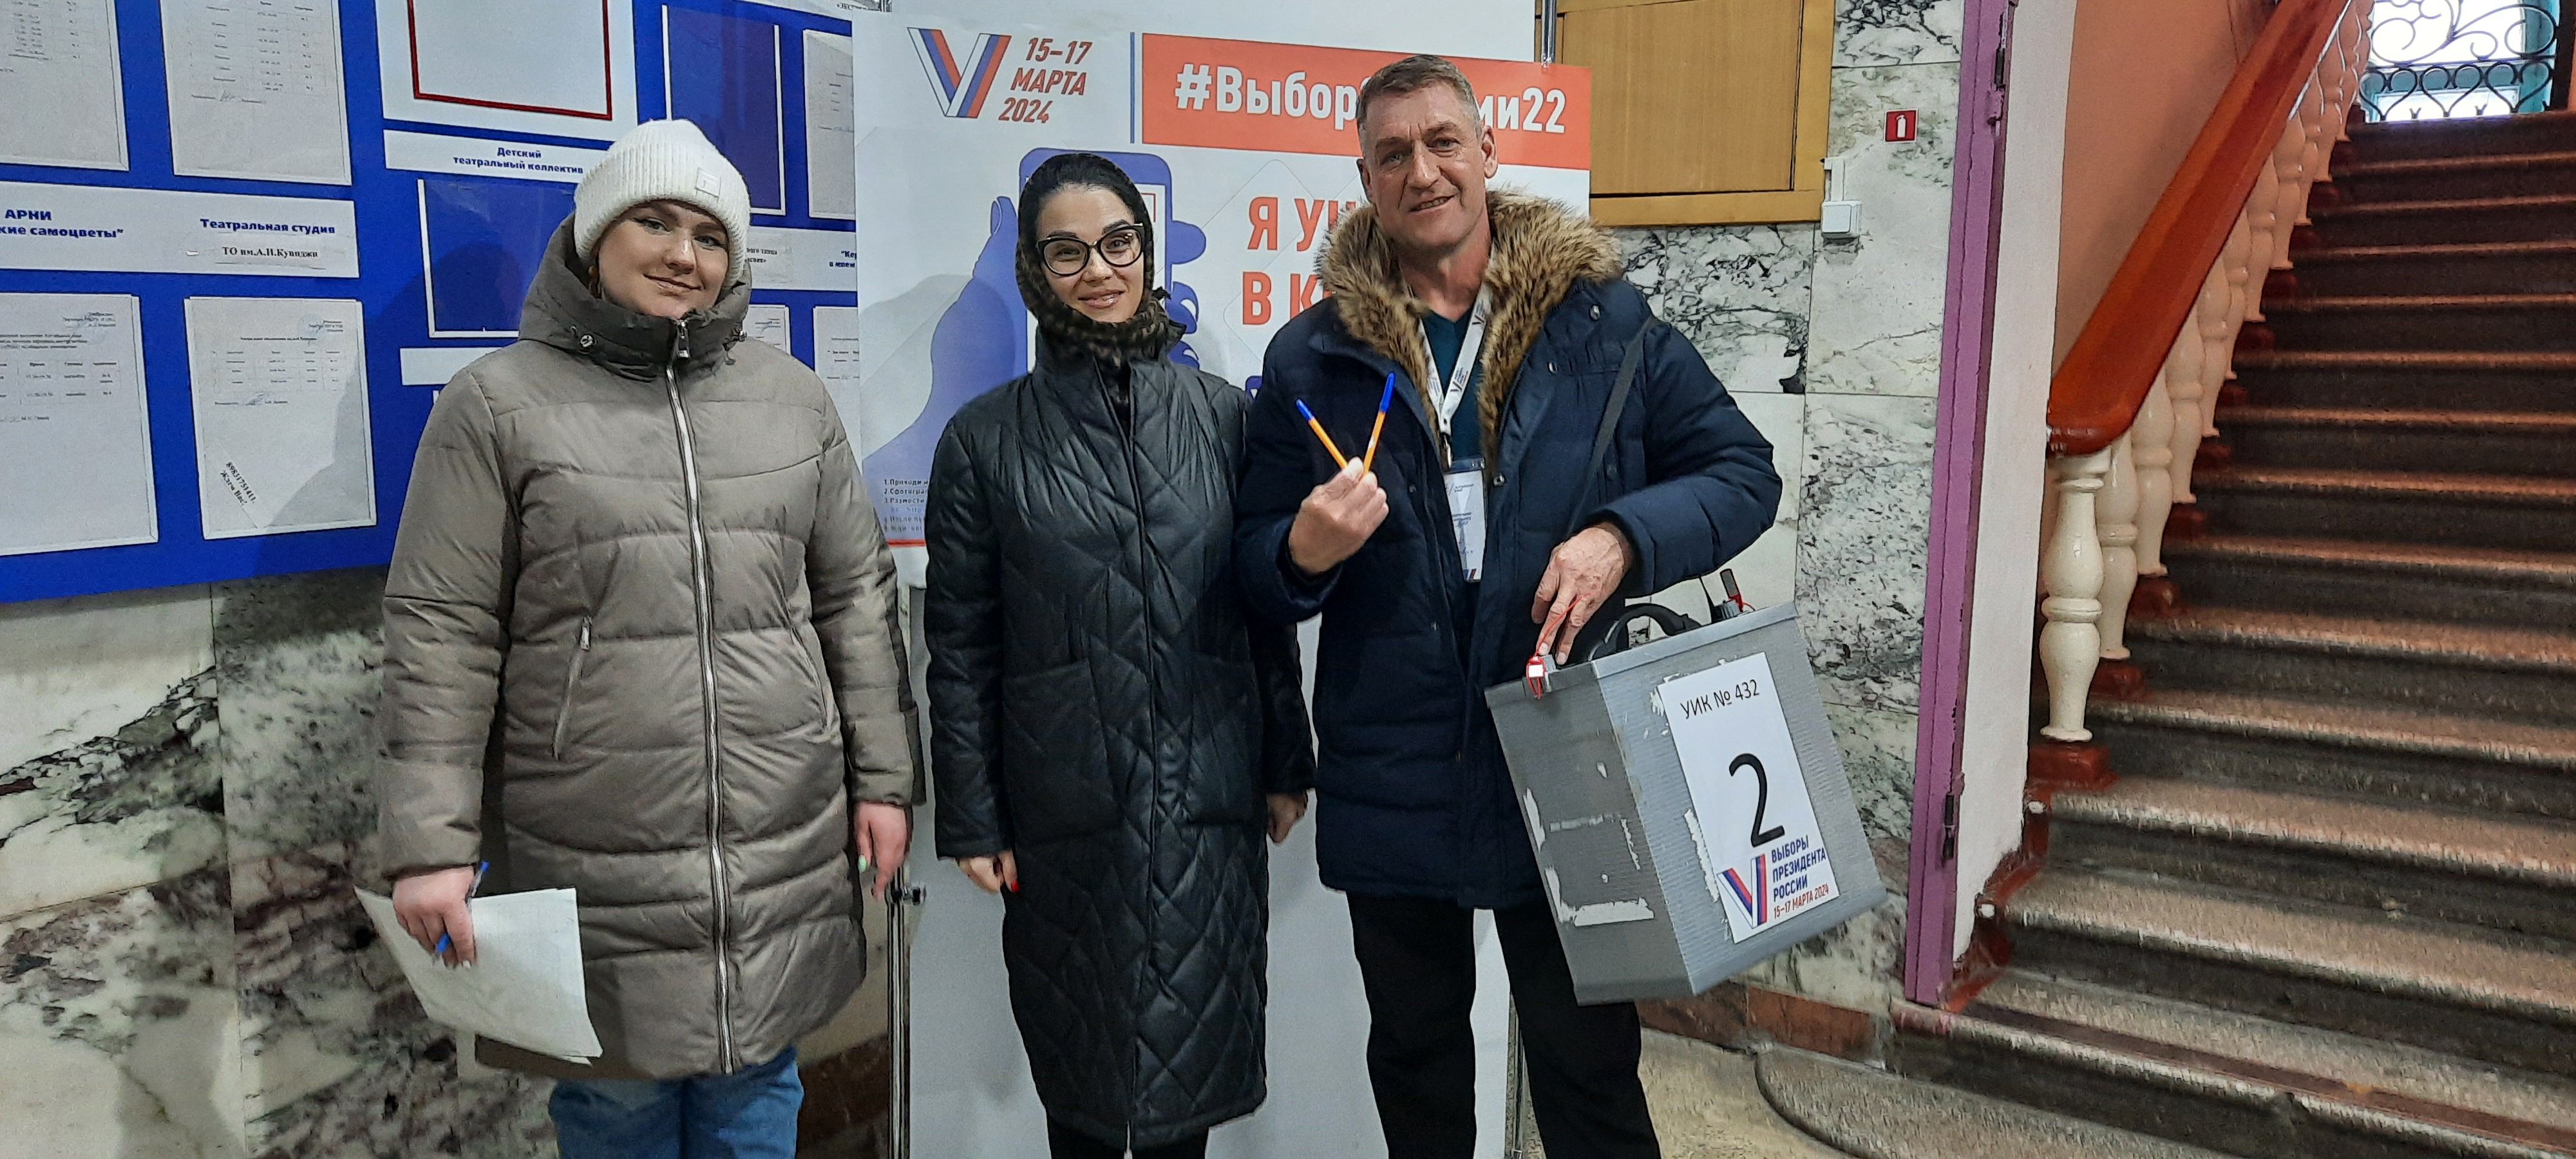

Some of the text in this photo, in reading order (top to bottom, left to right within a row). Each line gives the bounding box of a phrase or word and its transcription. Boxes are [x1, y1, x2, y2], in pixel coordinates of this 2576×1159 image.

[1010, 68, 1086, 95] МАРТА
[998, 97, 1053, 124] 2024
[453, 157, 583, 174] театральный коллектив
[497, 147, 542, 158] Детский
[5, 209, 52, 221] АРНИ
[200, 218, 336, 235] Театральная студия
[1247, 196, 1278, 250] Я
[222, 247, 238, 256] ТО
[1242, 271, 1272, 325] В
[1680, 679, 1761, 720] УИК № 432
[1728, 753, 1785, 848] 2
[1771, 834, 1810, 863] ВЫБОРЫ
[1772, 847, 1827, 883] ПРЕЗИДЕНТА
[1773, 874, 1808, 903] РОССИИ
[1792, 890, 1814, 911] МАРТА
[1814, 883, 1830, 900] 2024
